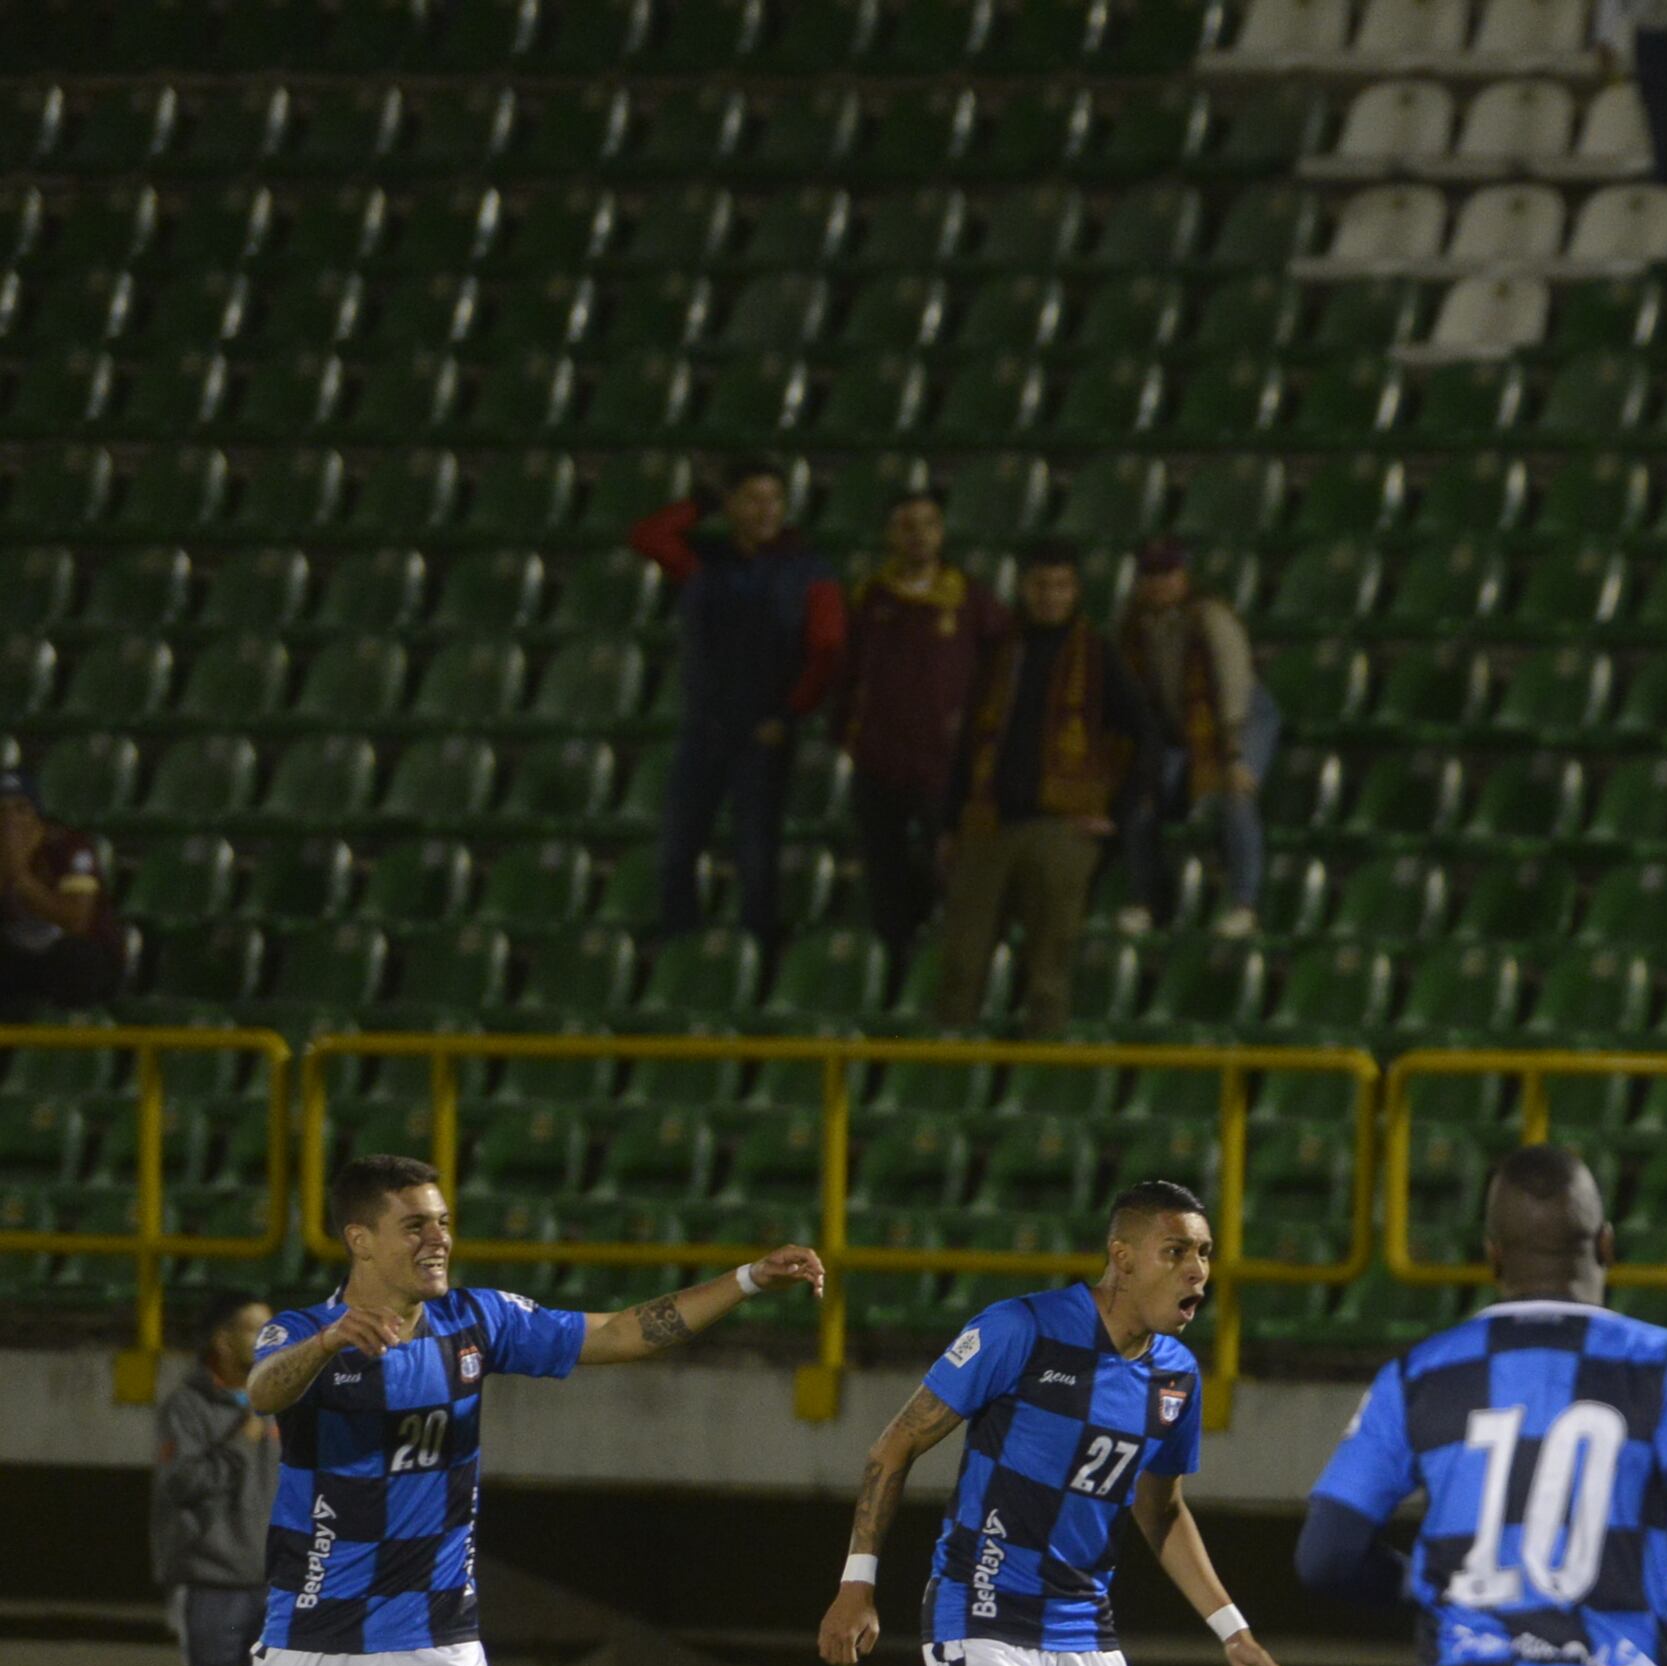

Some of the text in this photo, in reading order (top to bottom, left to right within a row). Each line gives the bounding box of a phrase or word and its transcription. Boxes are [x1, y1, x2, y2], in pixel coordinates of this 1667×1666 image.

[390, 1409, 448, 1473] 20
[1069, 1435, 1140, 1497] 27
[1443, 1399, 1629, 1607] 10
